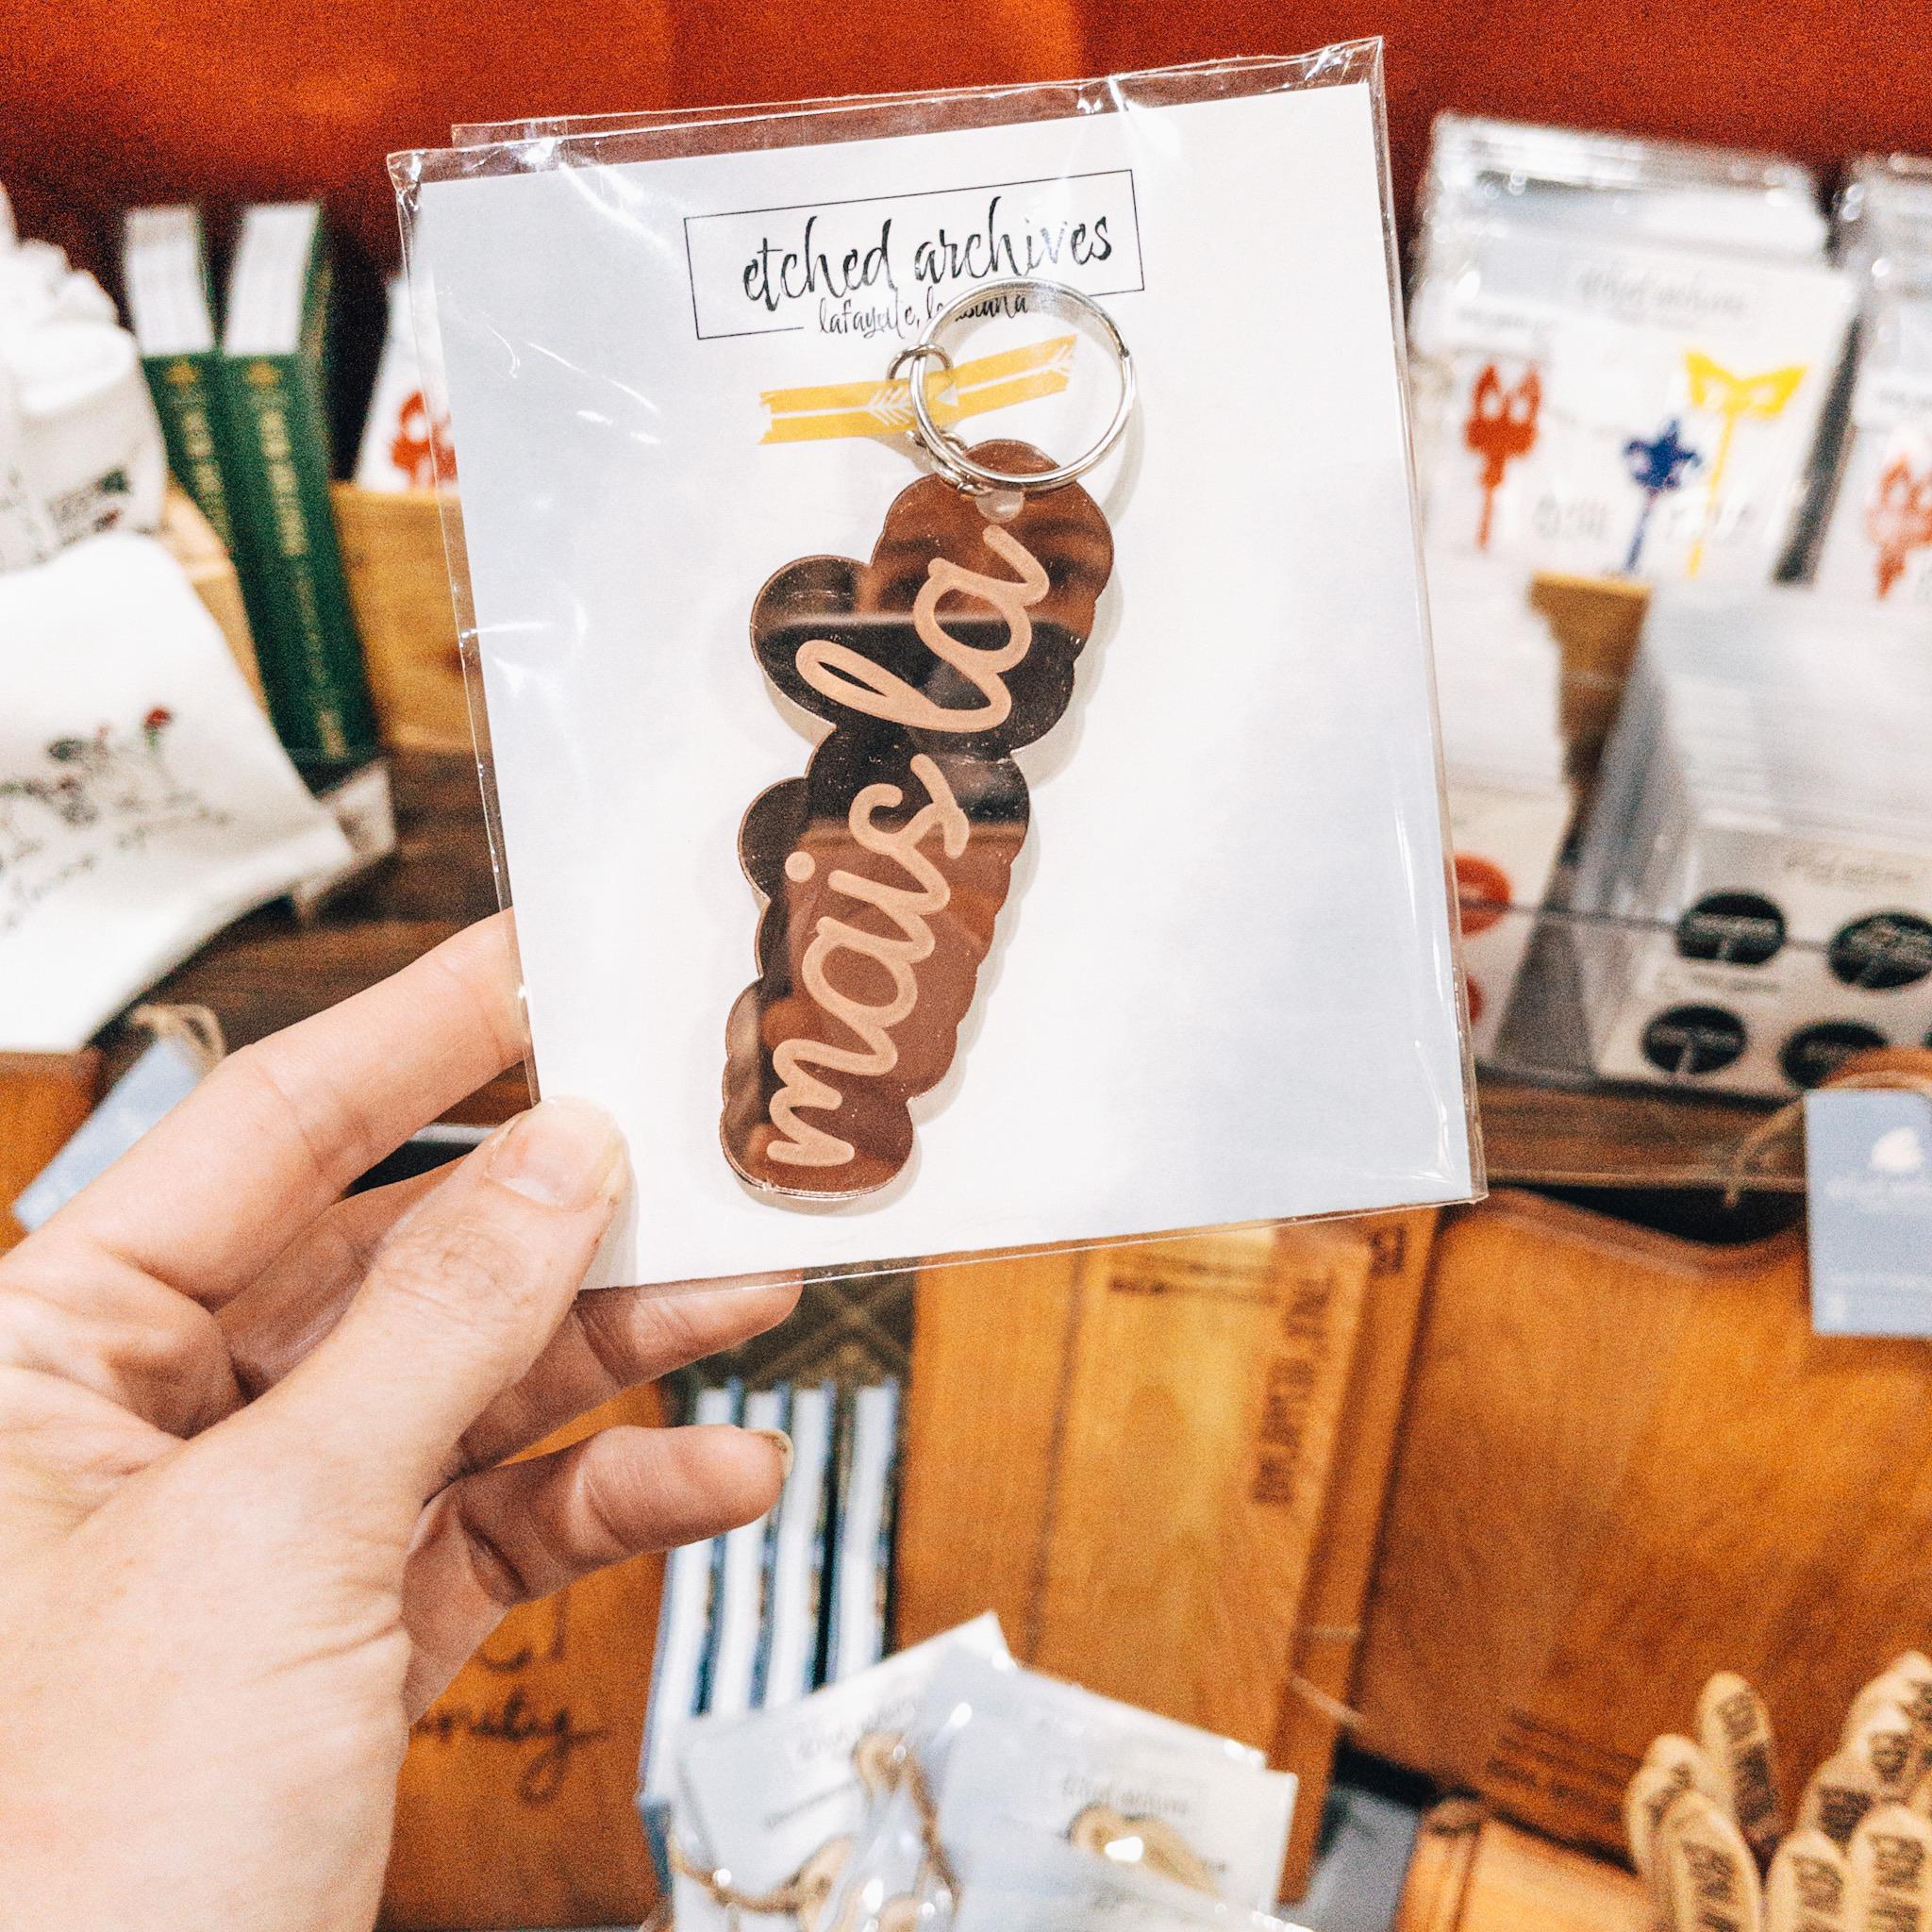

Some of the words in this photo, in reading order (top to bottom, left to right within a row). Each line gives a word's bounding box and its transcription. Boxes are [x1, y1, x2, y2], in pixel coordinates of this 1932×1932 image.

[743, 216, 897, 312] etched
[914, 196, 1112, 284] archives
[795, 525, 1050, 732] la
[768, 754, 970, 1168] mais
